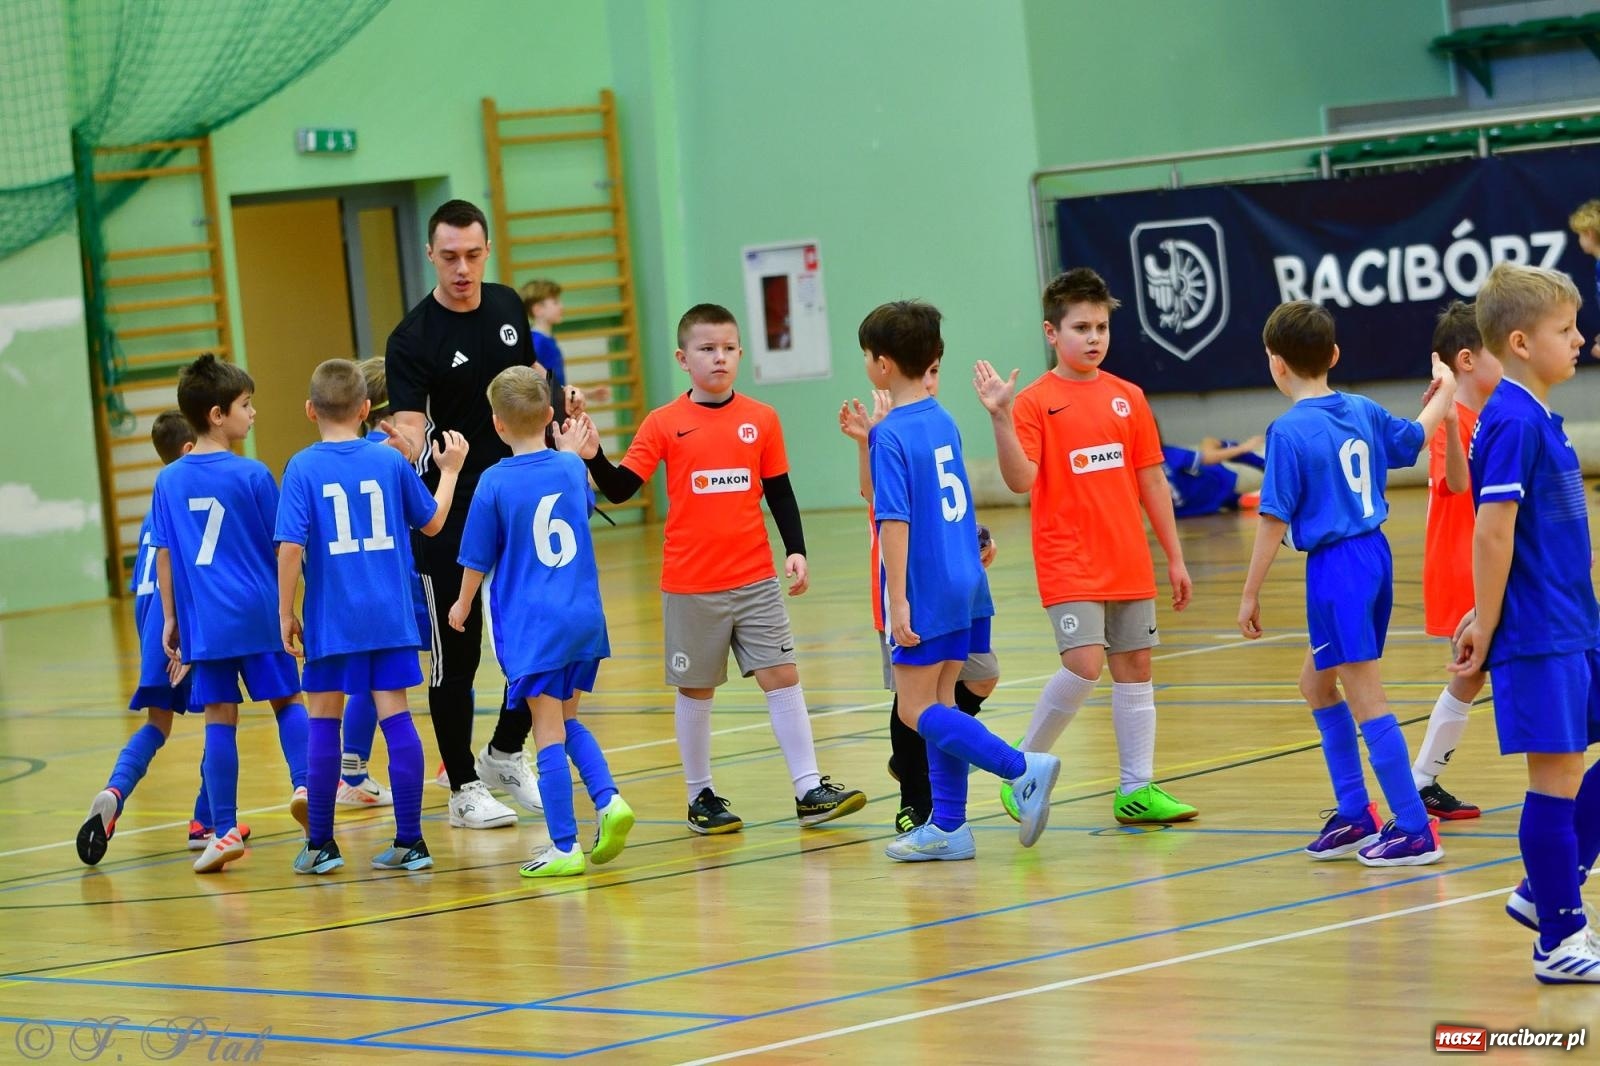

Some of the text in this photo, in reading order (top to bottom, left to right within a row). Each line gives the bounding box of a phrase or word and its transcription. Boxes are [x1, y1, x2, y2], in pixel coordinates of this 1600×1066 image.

[711, 475, 749, 486] PAKON
[934, 444, 967, 523] 5
[1338, 437, 1375, 519] 9
[188, 496, 226, 567] 7
[322, 479, 395, 556] 11
[532, 492, 578, 569] 6
